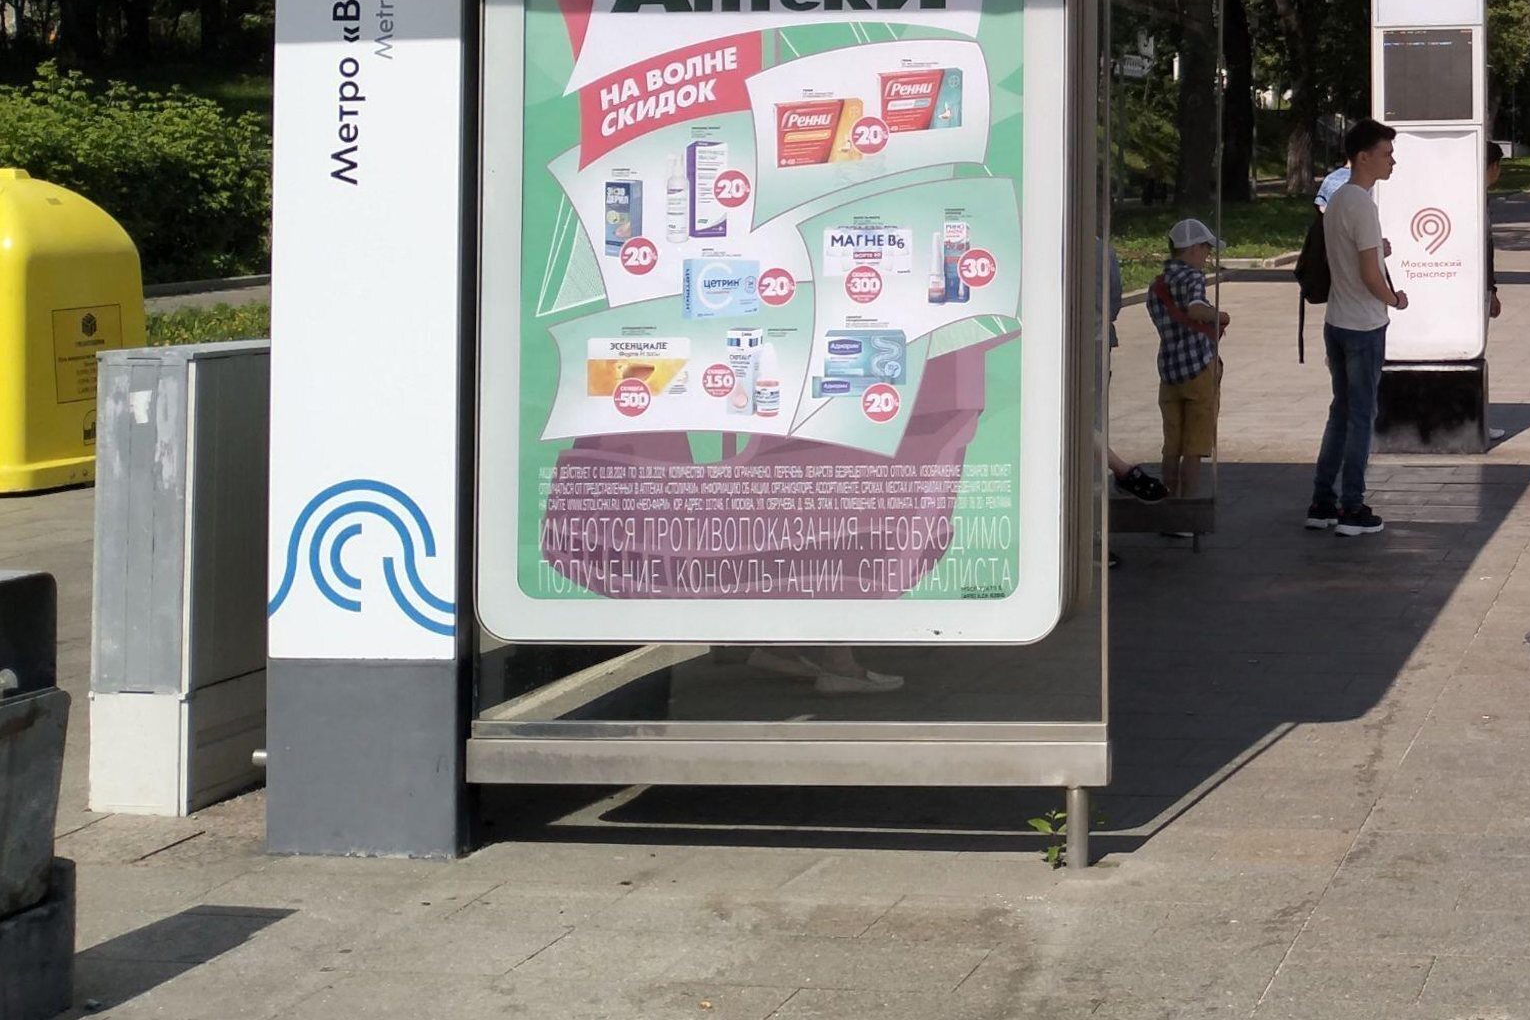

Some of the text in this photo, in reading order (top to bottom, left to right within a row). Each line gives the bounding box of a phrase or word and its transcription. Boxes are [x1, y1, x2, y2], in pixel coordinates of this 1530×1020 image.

[600, 46, 738, 111] НА ВОЛНЕ
[890, 82, 934, 96] Ренни
[601, 79, 717, 137] СКИДОК
[330, 56, 366, 186] Метро
[786, 113, 832, 128] Ренни
[830, 234, 884, 247] МАГНЕ
[1400, 259, 1462, 268] Московский
[1405, 269, 1457, 279] Транспорт
[609, 341, 668, 351] ЭССЕНЦИАЛЕ
[538, 515, 1012, 555] ИМЕЮТСЯ ПРОТИВОПОКАЗАНИЯ. НЕОБХОДИМО
[538, 557, 1013, 597] ПОЛУЧЕНИЕ КОНСУЛЬТАЦИИ СПЕЦИАЛИСТА
